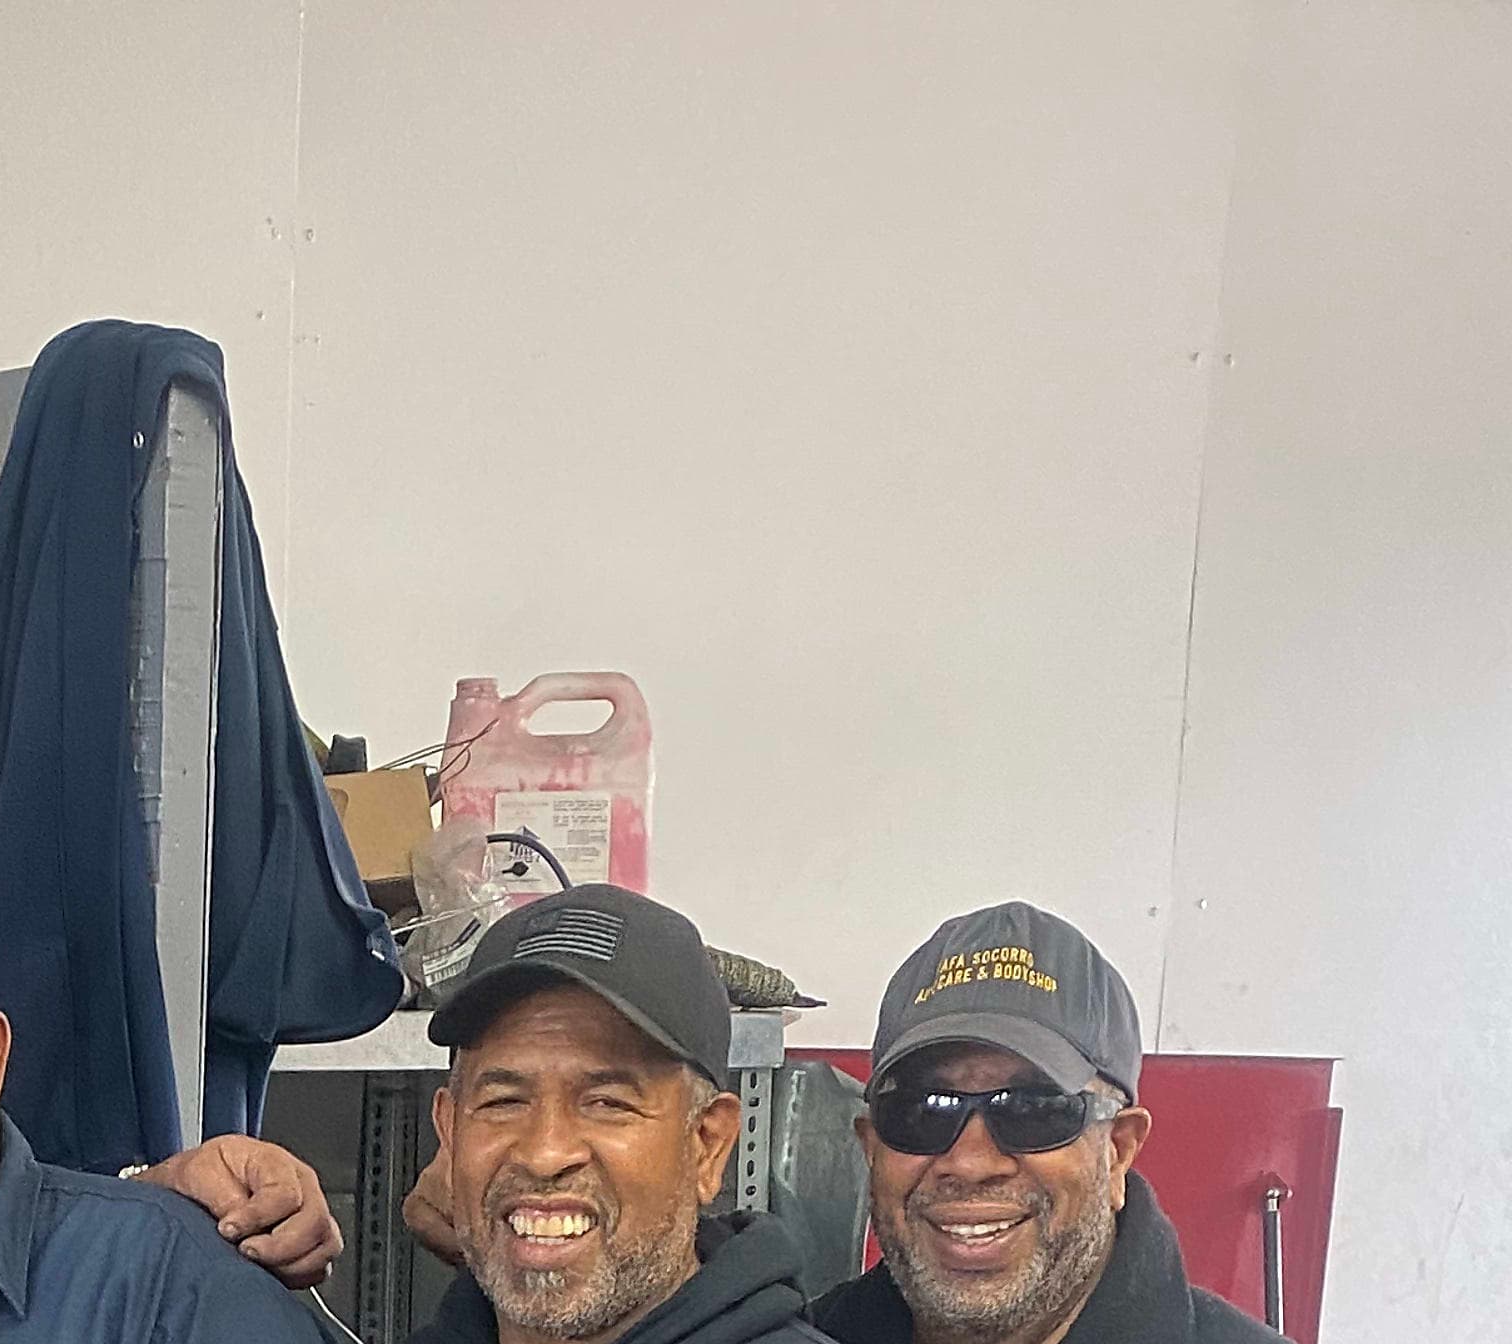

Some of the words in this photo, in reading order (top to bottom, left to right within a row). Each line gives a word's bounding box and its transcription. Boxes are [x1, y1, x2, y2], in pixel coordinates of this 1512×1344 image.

[972, 947, 1034, 967] SOCORRO
[937, 967, 973, 990] CARE
[976, 965, 989, 981] &
